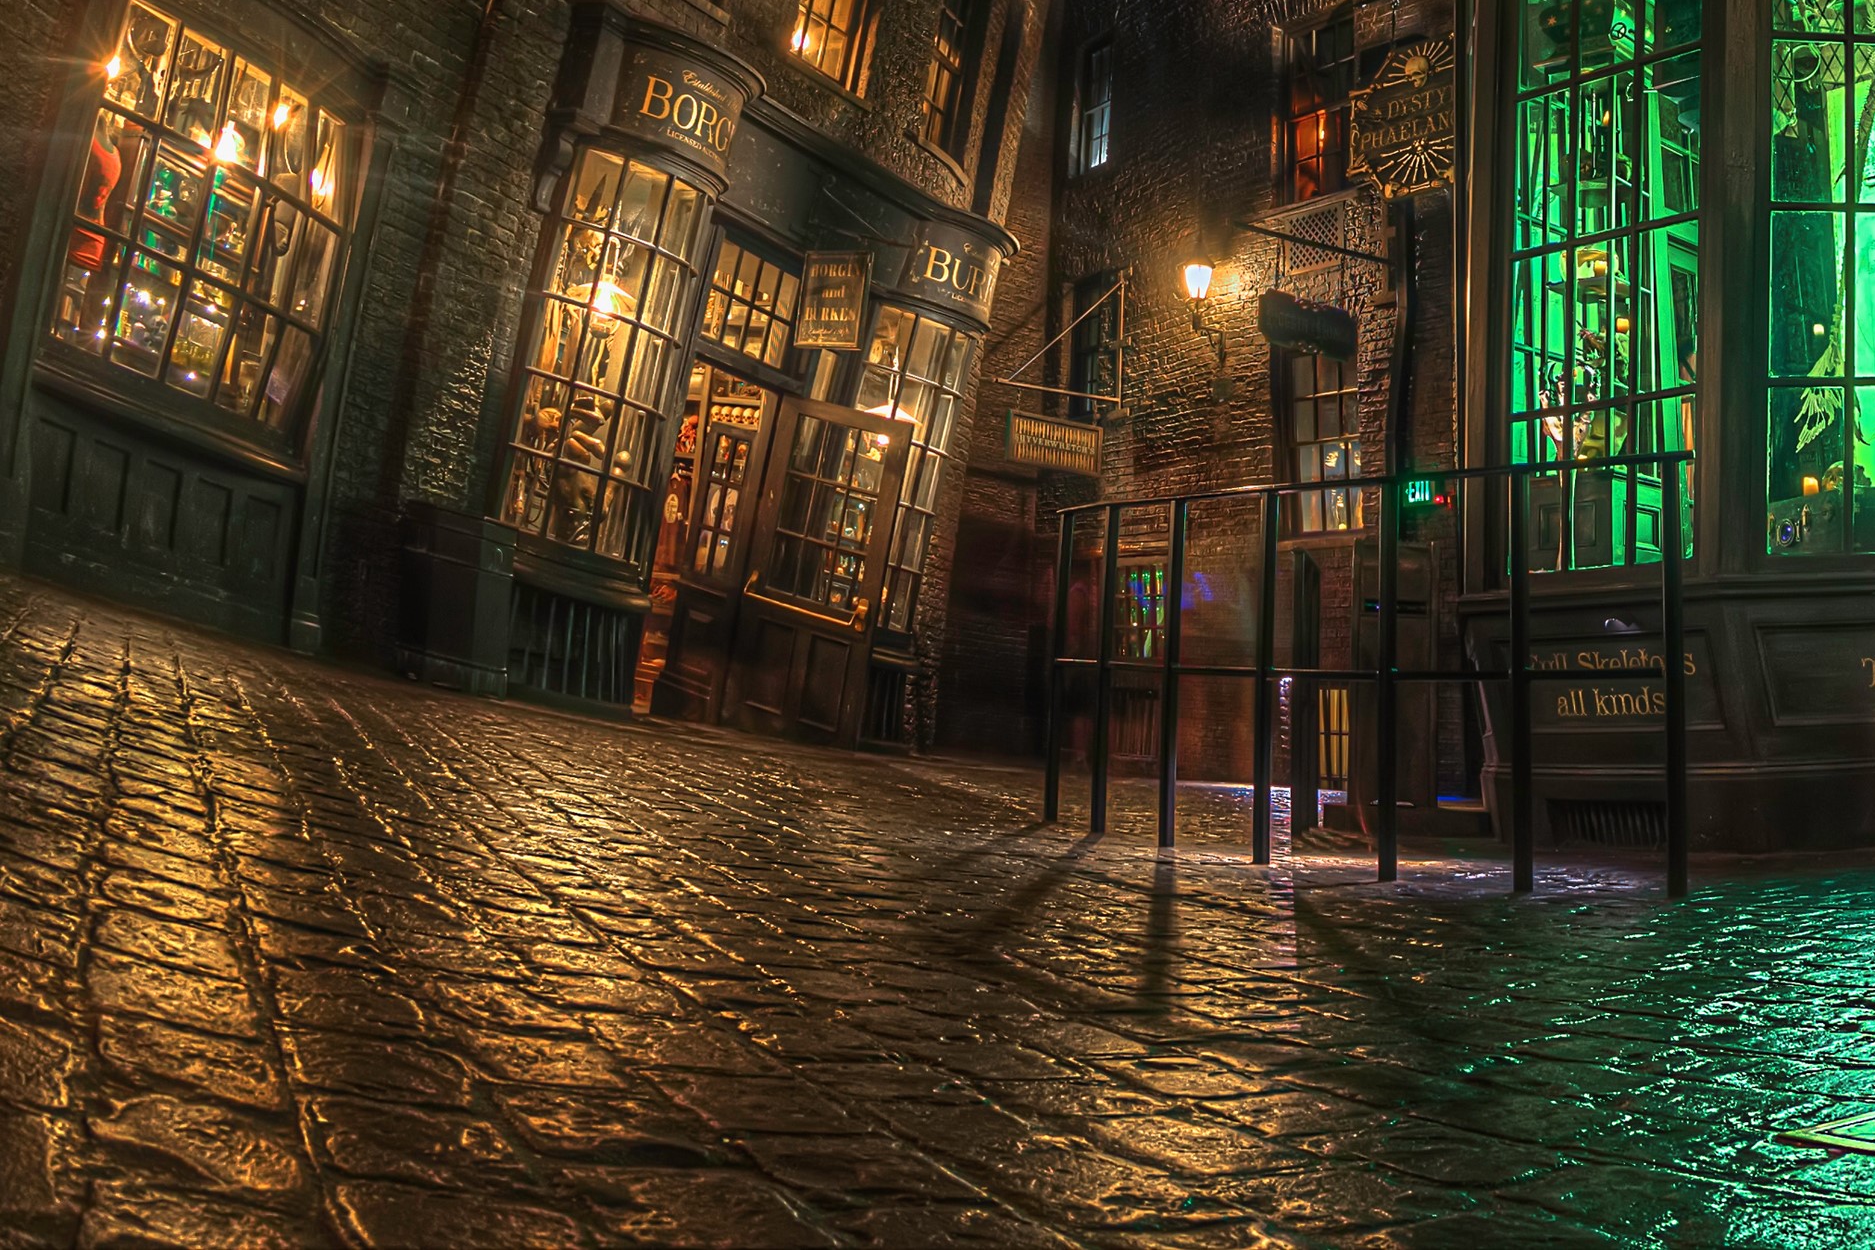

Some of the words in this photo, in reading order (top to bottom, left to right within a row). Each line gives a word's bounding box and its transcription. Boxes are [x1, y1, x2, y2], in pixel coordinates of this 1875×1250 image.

[666, 127, 702, 150] LICENSED
[821, 285, 846, 299] and
[1014, 432, 1096, 455] SHYVERWRETCH'S
[1408, 480, 1430, 503] EXIT
[1577, 648, 1697, 676] Skeletos
[1557, 688, 1588, 718] all
[1592, 686, 1667, 717] kinds
